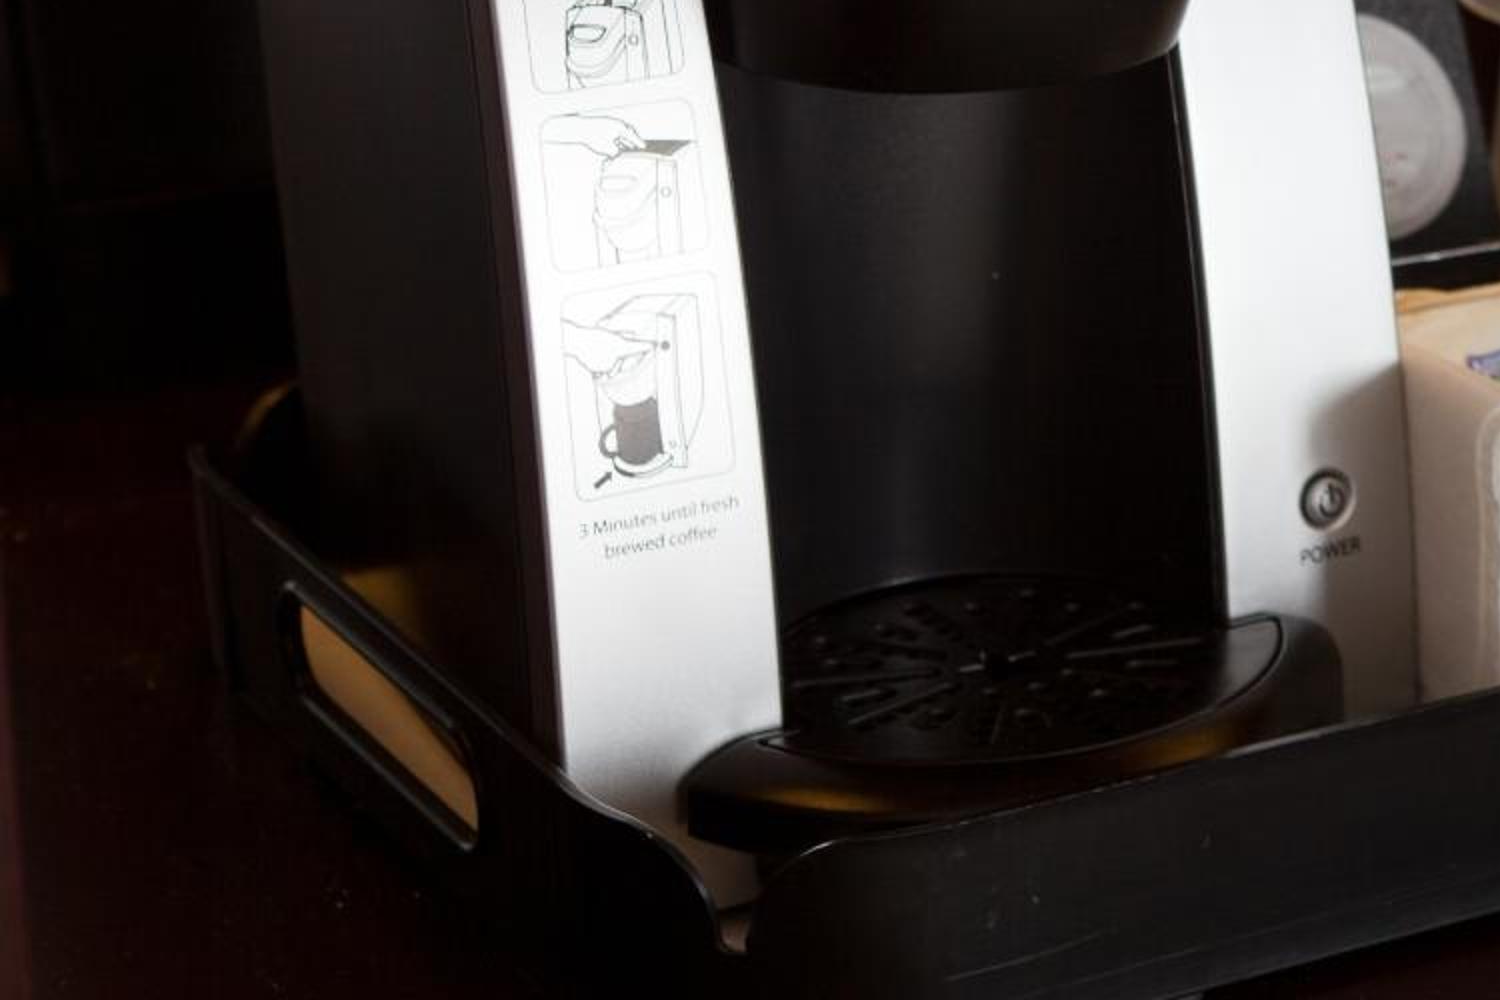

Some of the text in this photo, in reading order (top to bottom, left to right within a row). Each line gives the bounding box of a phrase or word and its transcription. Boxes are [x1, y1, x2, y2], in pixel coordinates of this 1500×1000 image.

[577, 494, 740, 539] 3 Minutes until fresh
[603, 525, 719, 560] brewed coffee
[1298, 536, 1361, 568] POWER
